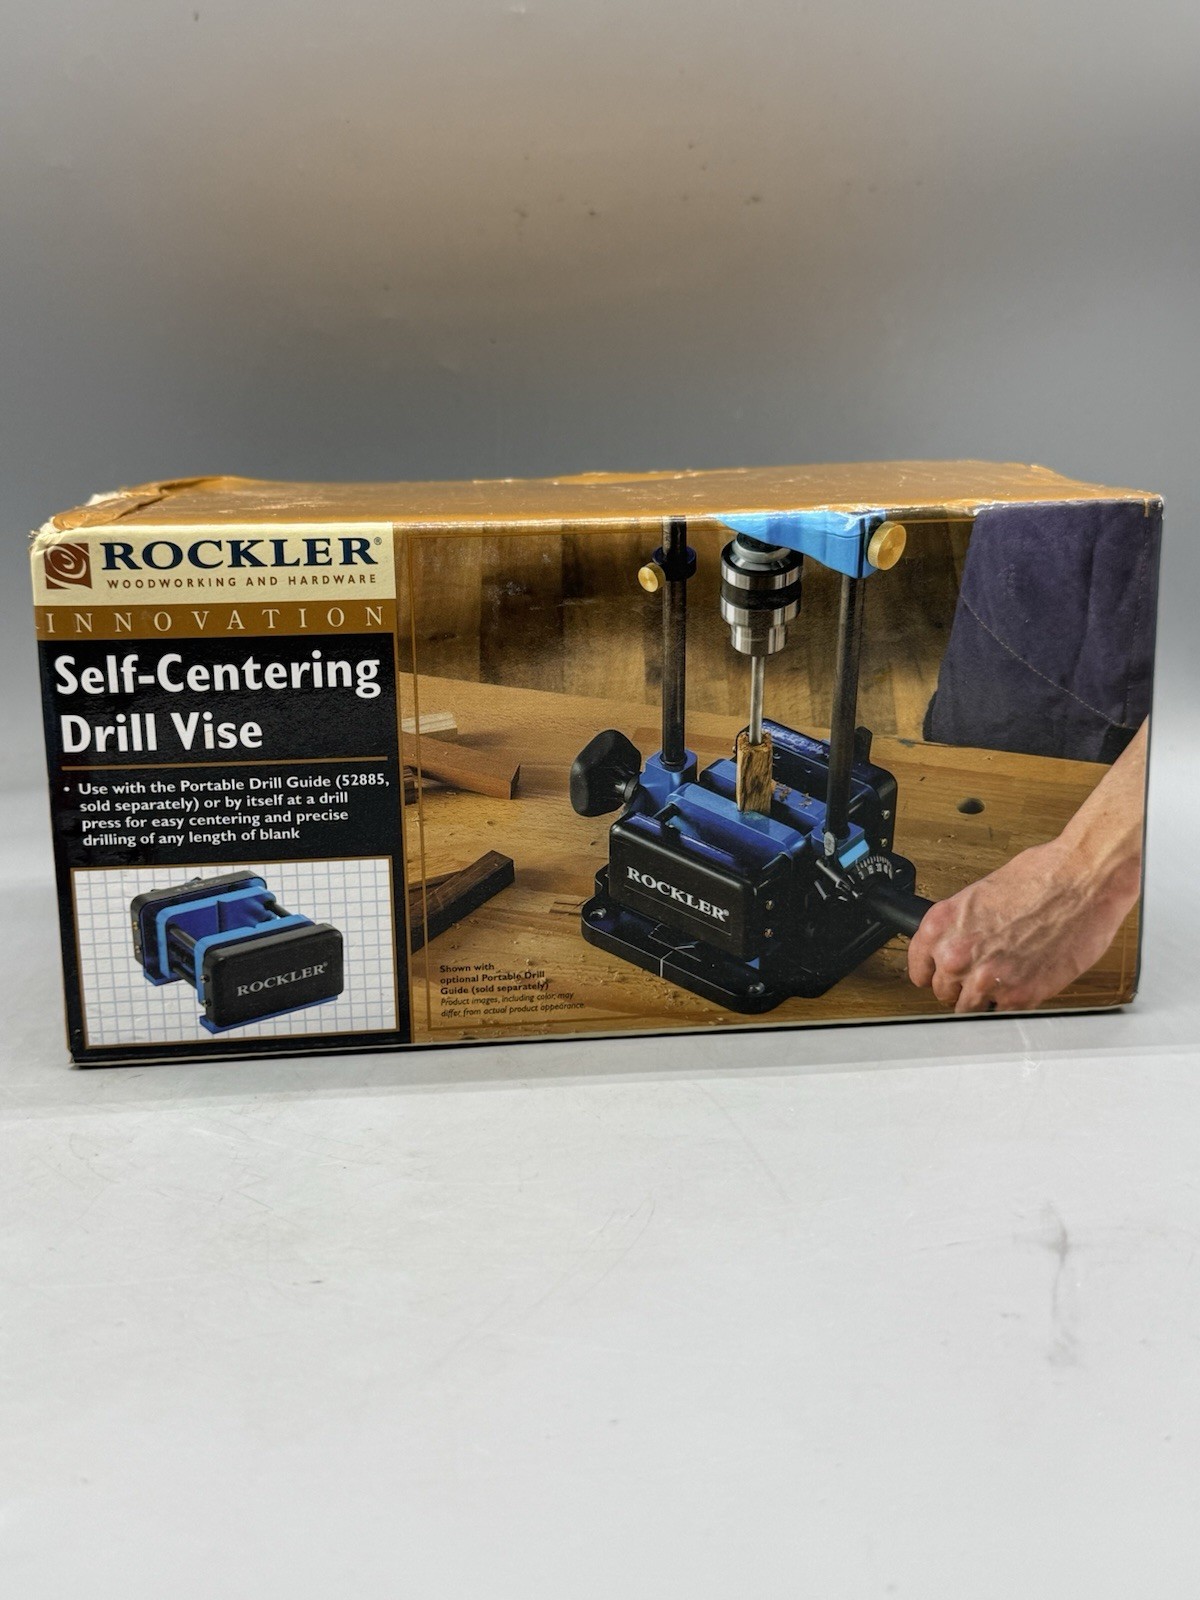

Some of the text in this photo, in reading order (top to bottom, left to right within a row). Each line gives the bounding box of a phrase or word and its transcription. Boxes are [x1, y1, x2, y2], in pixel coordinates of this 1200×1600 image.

[106, 573, 377, 589] WOODWORKING AND HARDWARE
[46, 606, 383, 633] INNOVATION
[54, 650, 381, 699] Self-Centering
[60, 711, 263, 753] Drill Vise
[78, 773, 390, 795] Use with the Portable Drill Guide (52885,
[80, 792, 348, 814] sold separately) or by itself at a drill
[82, 809, 349, 832] press for easy centering and precise
[83, 827, 300, 847] drilling of any length of blank
[440, 963, 495, 973] Shown with
[440, 971, 545, 985] optional Portable Drill
[440, 982, 549, 995] Guide (sold separately)
[441, 998, 469, 1006] Product
[471, 996, 500, 1006] images,
[501, 994, 535, 1004] including
[557, 993, 574, 1002] may
[441, 1009, 461, 1018] differ
[463, 1008, 481, 1017] from
[483, 1006, 508, 1015] actual
[509, 1005, 538, 1014] product
